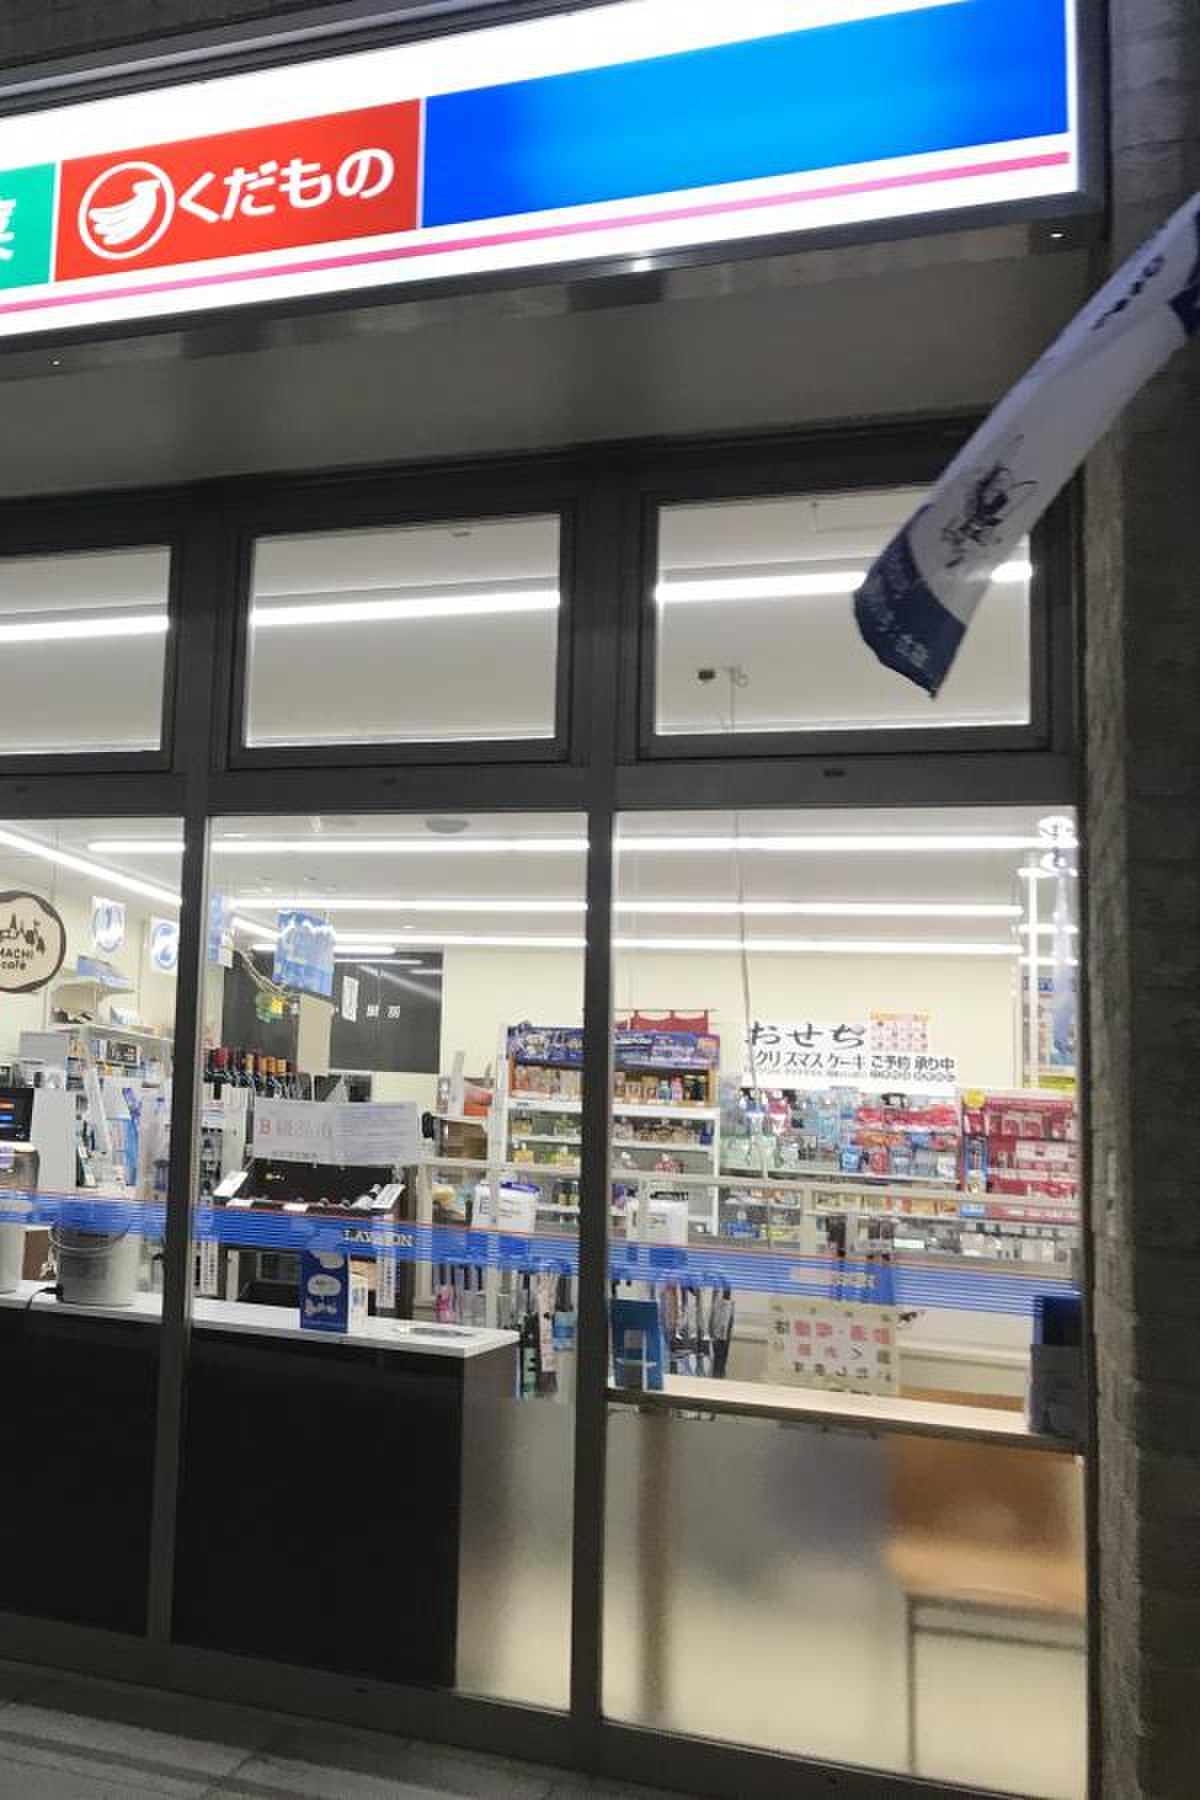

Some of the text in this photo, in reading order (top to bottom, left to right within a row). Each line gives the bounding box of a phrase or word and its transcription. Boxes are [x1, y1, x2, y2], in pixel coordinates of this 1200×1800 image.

[179, 148, 395, 224] くだもの
[745, 1020, 866, 1050] おせち
